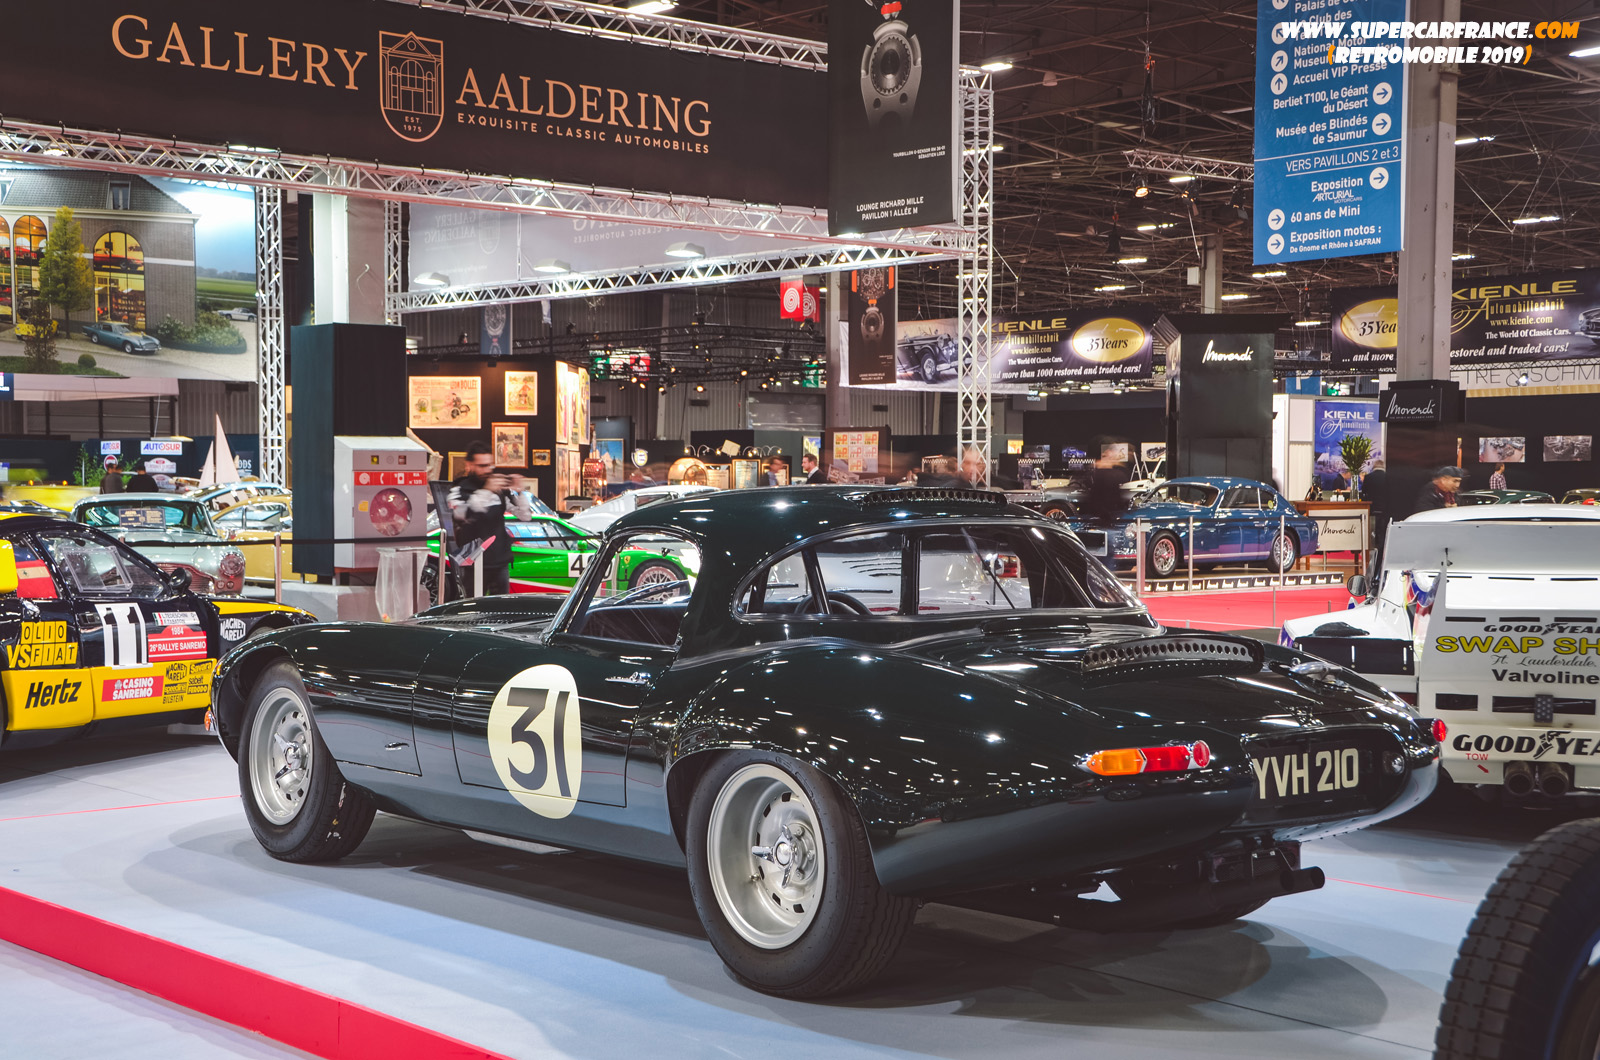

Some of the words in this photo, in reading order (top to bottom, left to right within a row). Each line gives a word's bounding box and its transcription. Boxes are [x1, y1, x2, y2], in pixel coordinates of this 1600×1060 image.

[1334, 10, 1353, 22] des
[112, 14, 368, 91] GALLERY
[1294, 39, 1335, 58] National
[1293, 69, 1329, 86] Accueil
[1331, 65, 1348, 78] VIP
[1351, 61, 1387, 75] Presse
[455, 67, 712, 138] AALDERING
[1273, 94, 1303, 110] Berliet
[1304, 90, 1329, 105] T100,
[1330, 89, 1339, 100] le
[1341, 84, 1369, 98] Géant
[1323, 102, 1335, 114] du
[1337, 98, 1368, 112] Désert
[404, 115, 424, 125] EST.
[1276, 124, 1307, 139] Musée
[1309, 121, 1327, 133] des
[1329, 113, 1368, 130] Blindés
[403, 124, 423, 133] 1975
[457, 112, 539, 133] EXQUISITE
[546, 124, 606, 142] CLASSIC
[614, 133, 710, 154] AUTOMOBILES
[1312, 134, 1325, 145] de
[1327, 128, 1368, 143] Saumur
[1286, 158, 1312, 173] VERS
[1314, 150, 1370, 169] PAVILLONS
[1371, 149, 1378, 160] 2
[1380, 147, 1391, 159] et
[1392, 146, 1399, 158] 3
[1311, 177, 1363, 193] Exposition
[1312, 189, 1354, 202] ARTCURIAL
[856, 201, 879, 212] LOUNGE
[879, 198, 905, 209] RICHARD
[906, 196, 924, 206] MILLE
[861, 210, 889, 221] PAVILLON
[889, 210, 893, 218] 1
[893, 206, 912, 217] ALLÉE
[912, 206, 918, 214] M
[1290, 212, 1302, 223] 60
[1304, 210, 1322, 222] ans
[1324, 207, 1336, 219] de
[1339, 204, 1360, 217] Mini
[1290, 229, 1341, 244] Exposition
[1343, 225, 1376, 237] motos
[1290, 246, 1298, 254] De
[1299, 244, 1320, 253] Gnome
[1329, 240, 1348, 250] Rhône
[1354, 237, 1382, 247] SAFRAN
[1490, 315, 1553, 327] www.kienle.com
[1485, 331, 1499, 340] The
[1500, 330, 1519, 339] World
[1520, 329, 1529, 338] Of
[1529, 328, 1553, 337] Classic
[1553, 327, 1572, 337] Cars.
[1011, 346, 1052, 355] www.kienle.com
[1353, 352, 1370, 362] and
[1371, 353, 1394, 362] more
[1450, 345, 1486, 358] estored
[1487, 344, 1506, 356] and
[1508, 342, 1541, 355] traded
[1543, 341, 1569, 353] cars!
[1008, 358, 1017, 366] The
[1017, 357, 1030, 365] World
[1002, 371, 1018, 379] more
[1020, 369, 1035, 378] than
[1036, 368, 1053, 378] 1000
[1054, 365, 1083, 377] restored
[1084, 364, 1098, 375] and
[1099, 363, 1123, 374] traded
[1123, 363, 1142, 374] cars!
[1386, 393, 1436, 418] Movendi
[1324, 410, 1375, 420] KIENLE
[143, 442, 181, 451] AUTOSUR
[1320, 520, 1357, 535] Movendi
[22, 623, 66, 642] OLIO
[100, 605, 146, 667] 11
[171, 626, 185, 636] 1984
[179, 640, 207, 650] SANREMO
[1435, 635, 1544, 654] SWAP
[31, 643, 77, 665] FIAT
[123, 677, 154, 690] CASINO
[1491, 668, 1600, 685] Valvoline
[25, 678, 82, 709] Hertz
[112, 687, 153, 700] SANREMO
[162, 694, 184, 705] BILSTEIN
[507, 687, 570, 798] 31
[1466, 752, 1489, 761] TOW
[1251, 752, 1310, 800] YVH
[1315, 747, 1359, 792] 210
